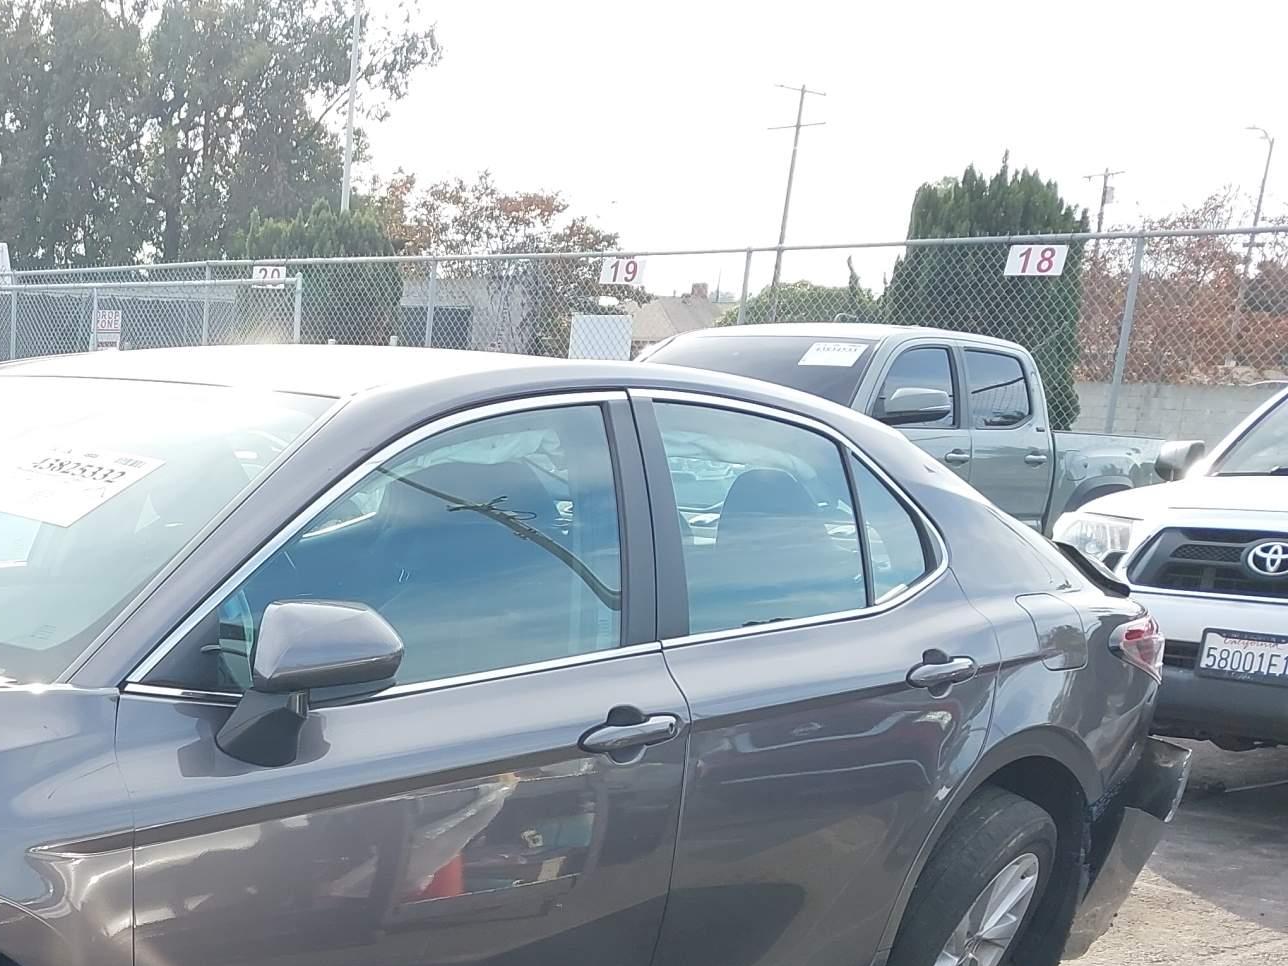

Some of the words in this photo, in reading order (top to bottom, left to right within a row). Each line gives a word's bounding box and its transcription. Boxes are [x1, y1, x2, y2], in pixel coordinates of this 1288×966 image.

[610, 259, 638, 282] 19
[1019, 247, 1056, 273] 18
[258, 267, 281, 287] 20
